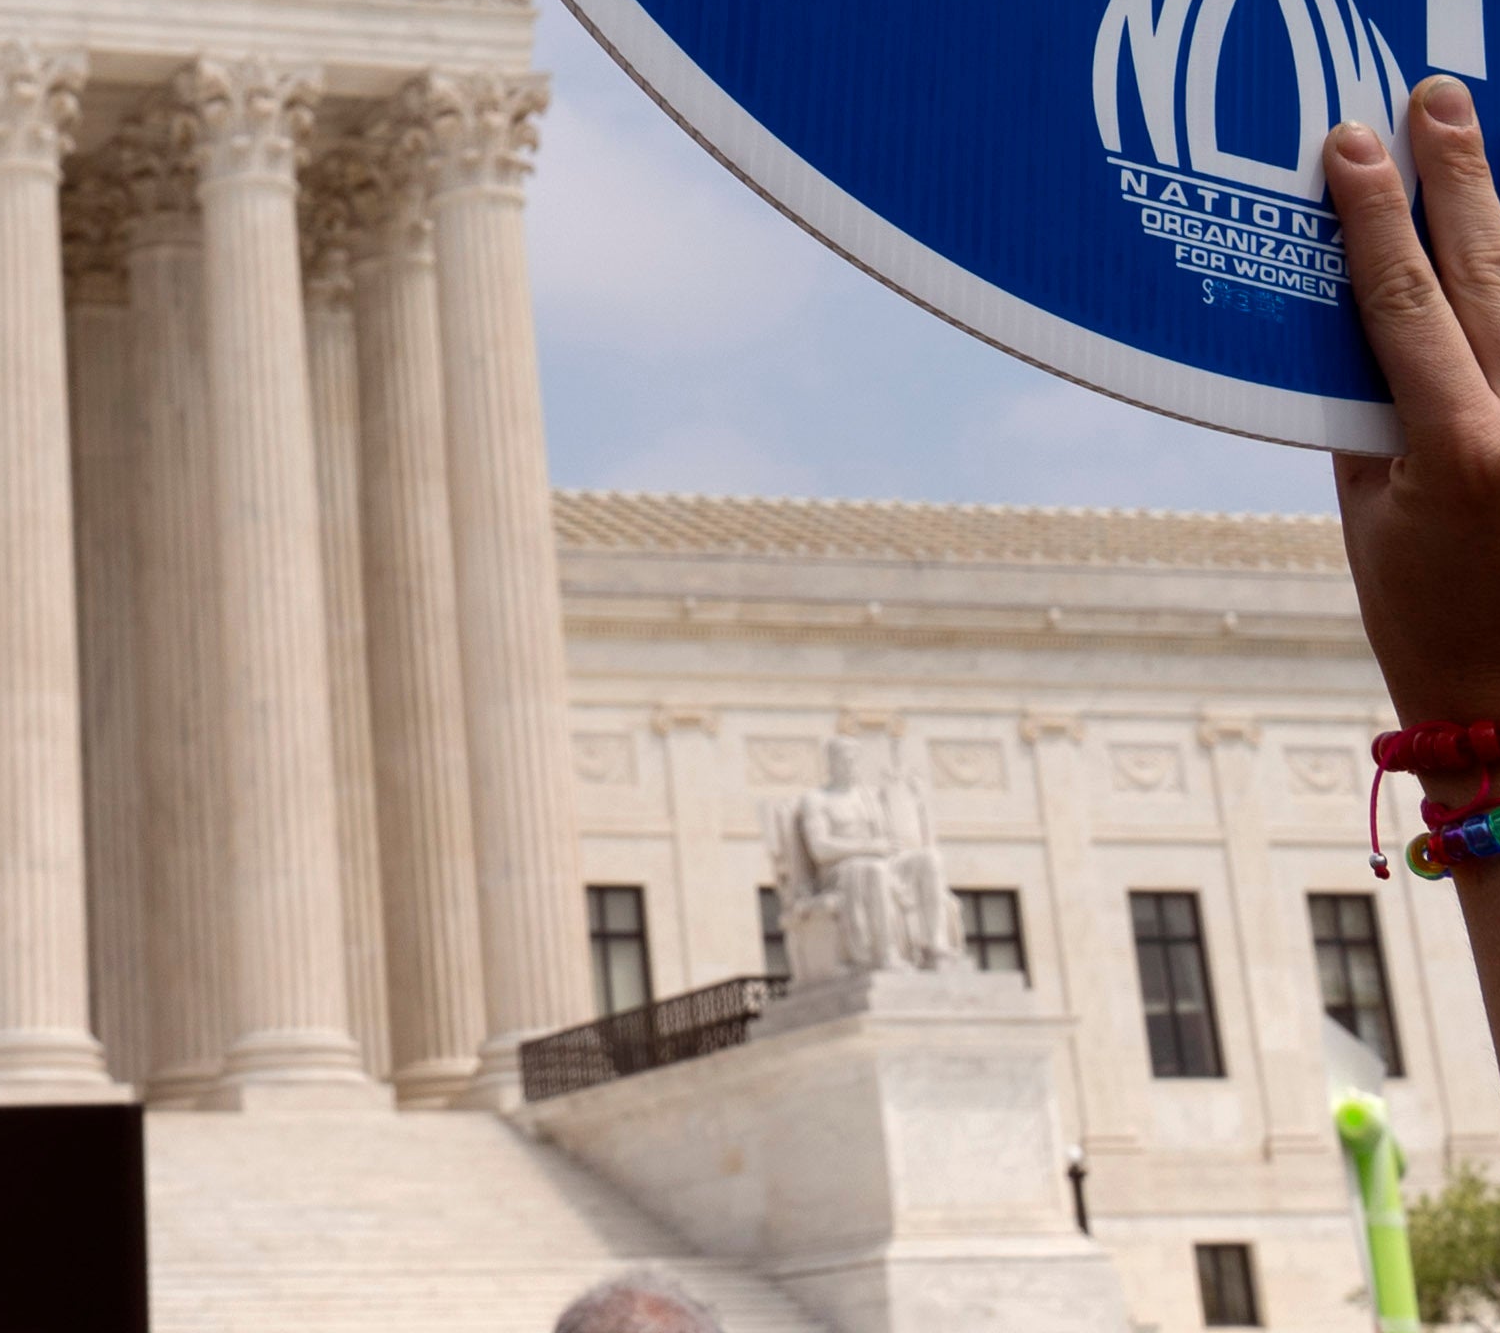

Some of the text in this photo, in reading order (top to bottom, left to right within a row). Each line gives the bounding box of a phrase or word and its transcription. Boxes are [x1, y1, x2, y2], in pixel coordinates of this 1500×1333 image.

[1121, 169, 1345, 246] NATION
[1141, 208, 1349, 277] ORGANIZATIO
[1175, 244, 1337, 298] FOR WOMEN
